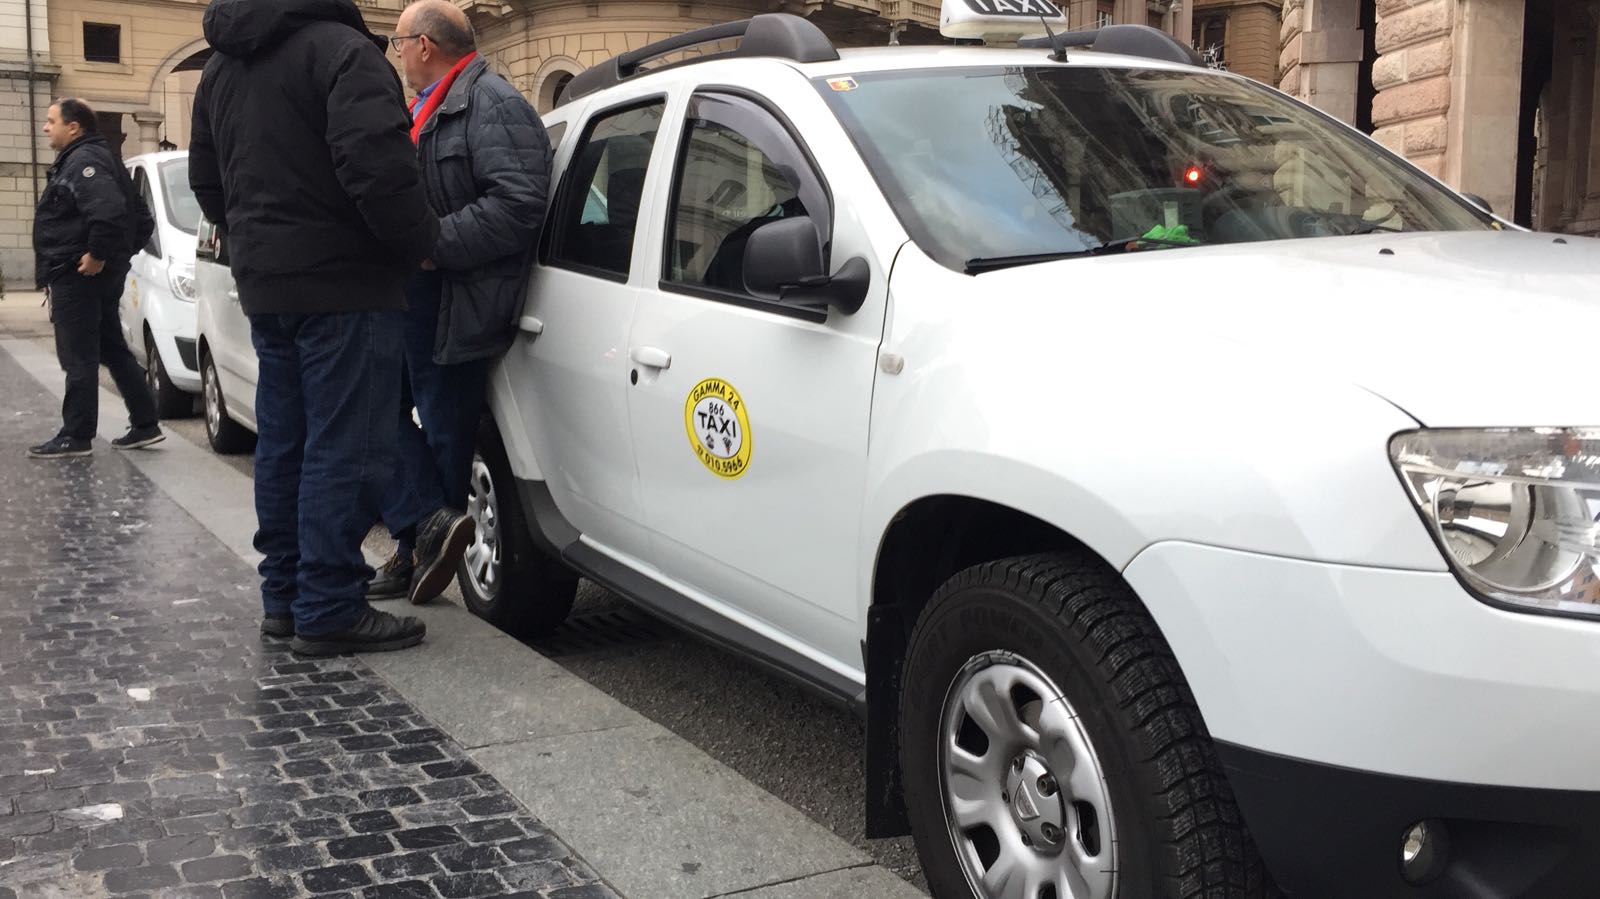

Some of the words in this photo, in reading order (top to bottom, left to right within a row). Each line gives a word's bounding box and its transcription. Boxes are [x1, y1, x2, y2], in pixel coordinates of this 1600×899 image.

[693, 382, 725, 402] GAMMA
[728, 391, 739, 410] 24
[708, 402, 725, 416] 866
[698, 411, 736, 438] TAXI
